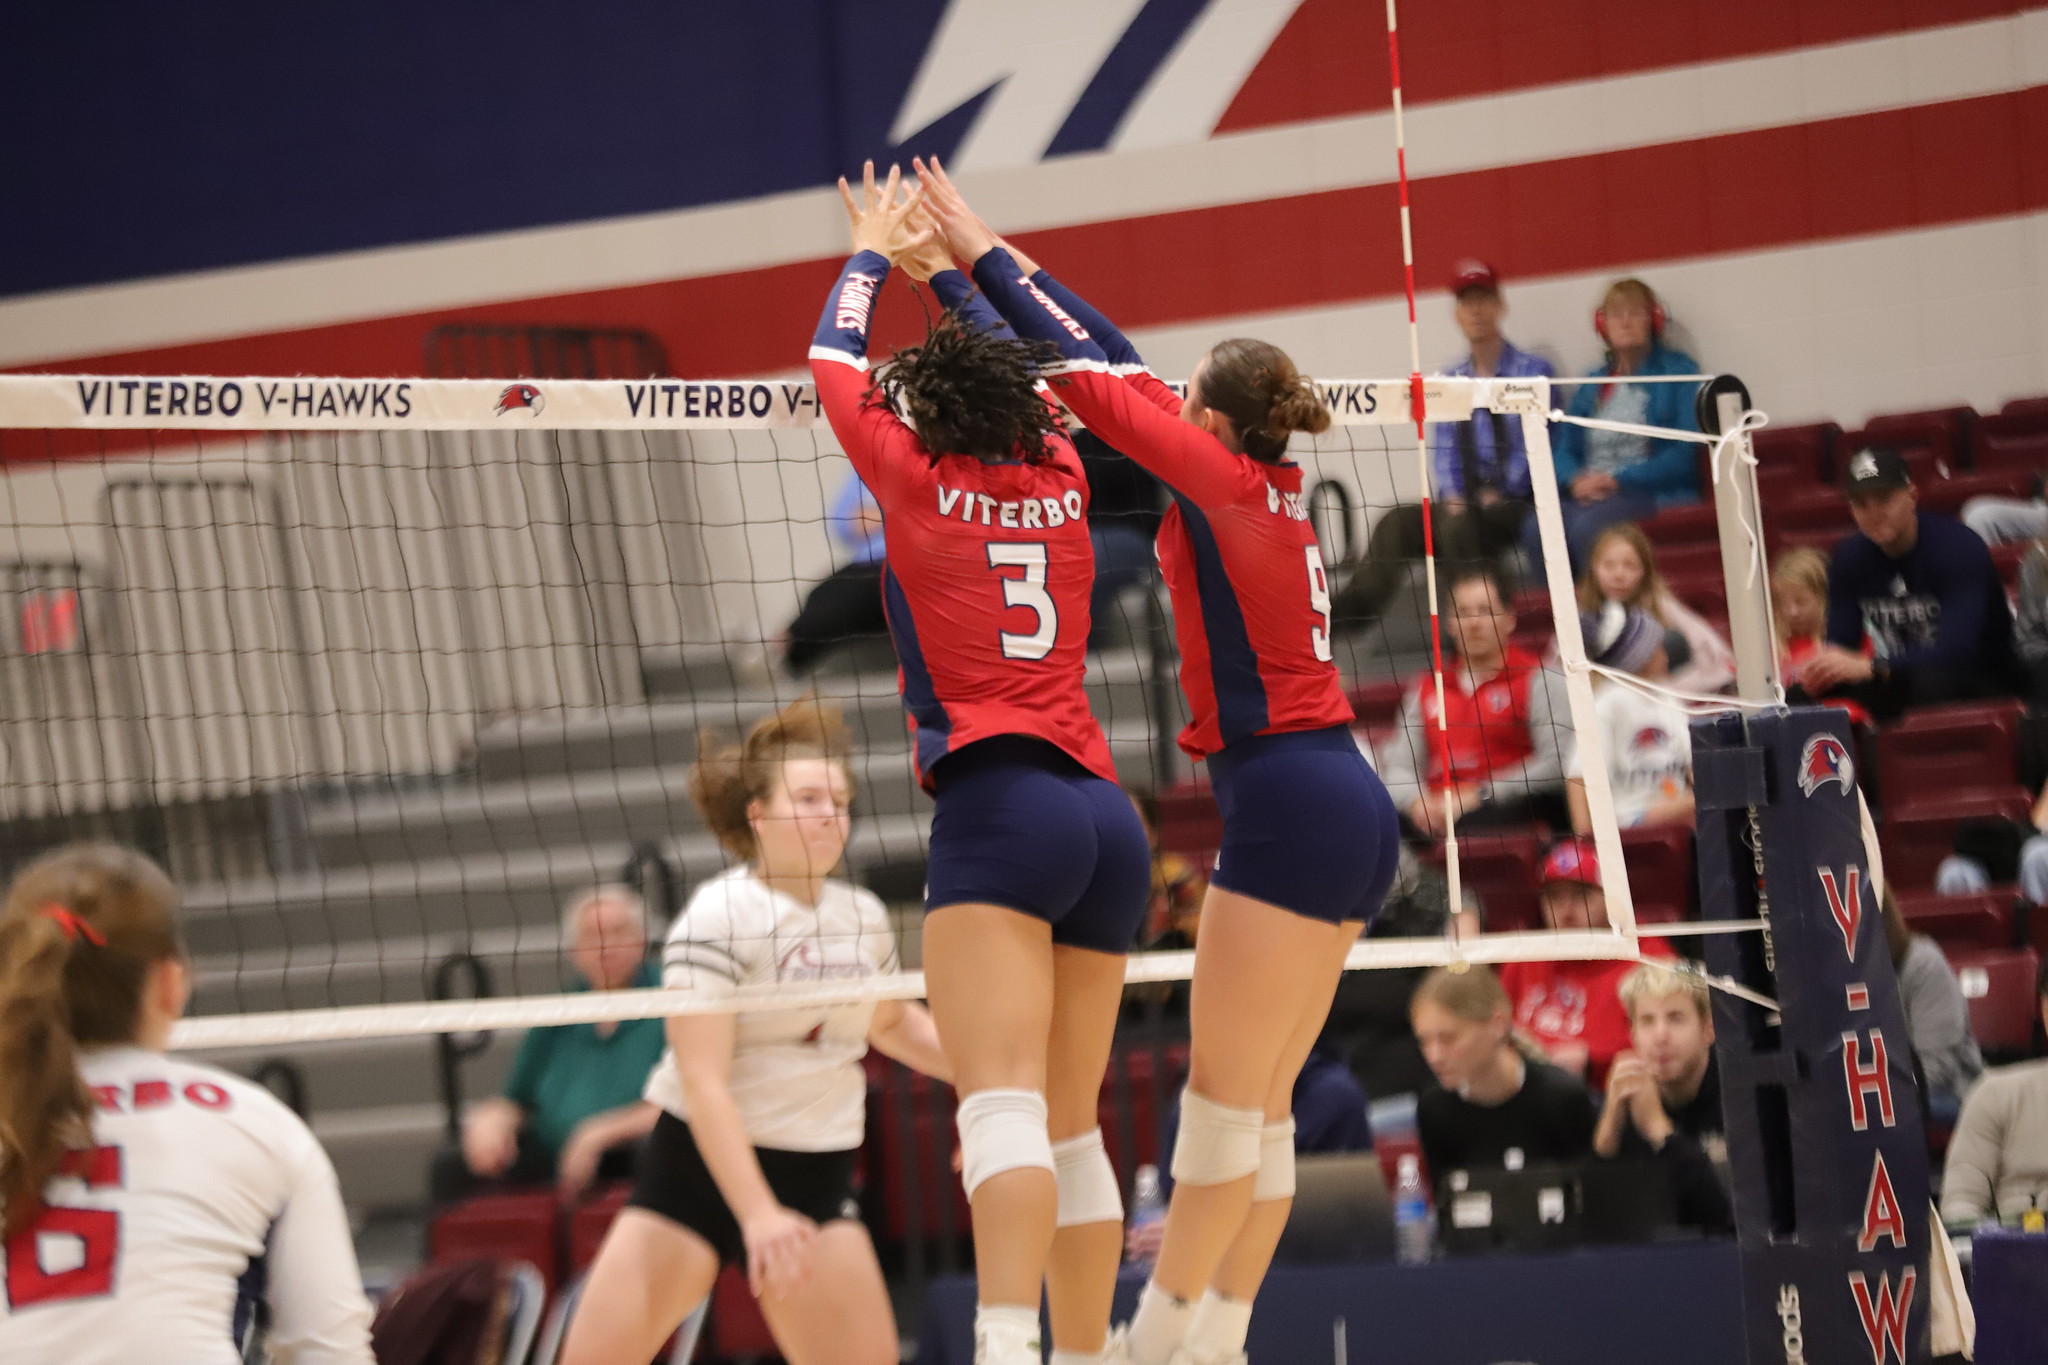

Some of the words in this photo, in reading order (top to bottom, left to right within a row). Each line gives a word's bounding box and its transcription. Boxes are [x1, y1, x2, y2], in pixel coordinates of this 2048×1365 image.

[76, 380, 243, 417] VITERBO
[255, 382, 412, 418] V-HAWKS
[624, 384, 772, 418] VITERBO
[938, 484, 1083, 529] VITERBO
[985, 541, 1059, 661] 3
[1304, 544, 1334, 662] 9
[4, 1145, 126, 1313] 6
